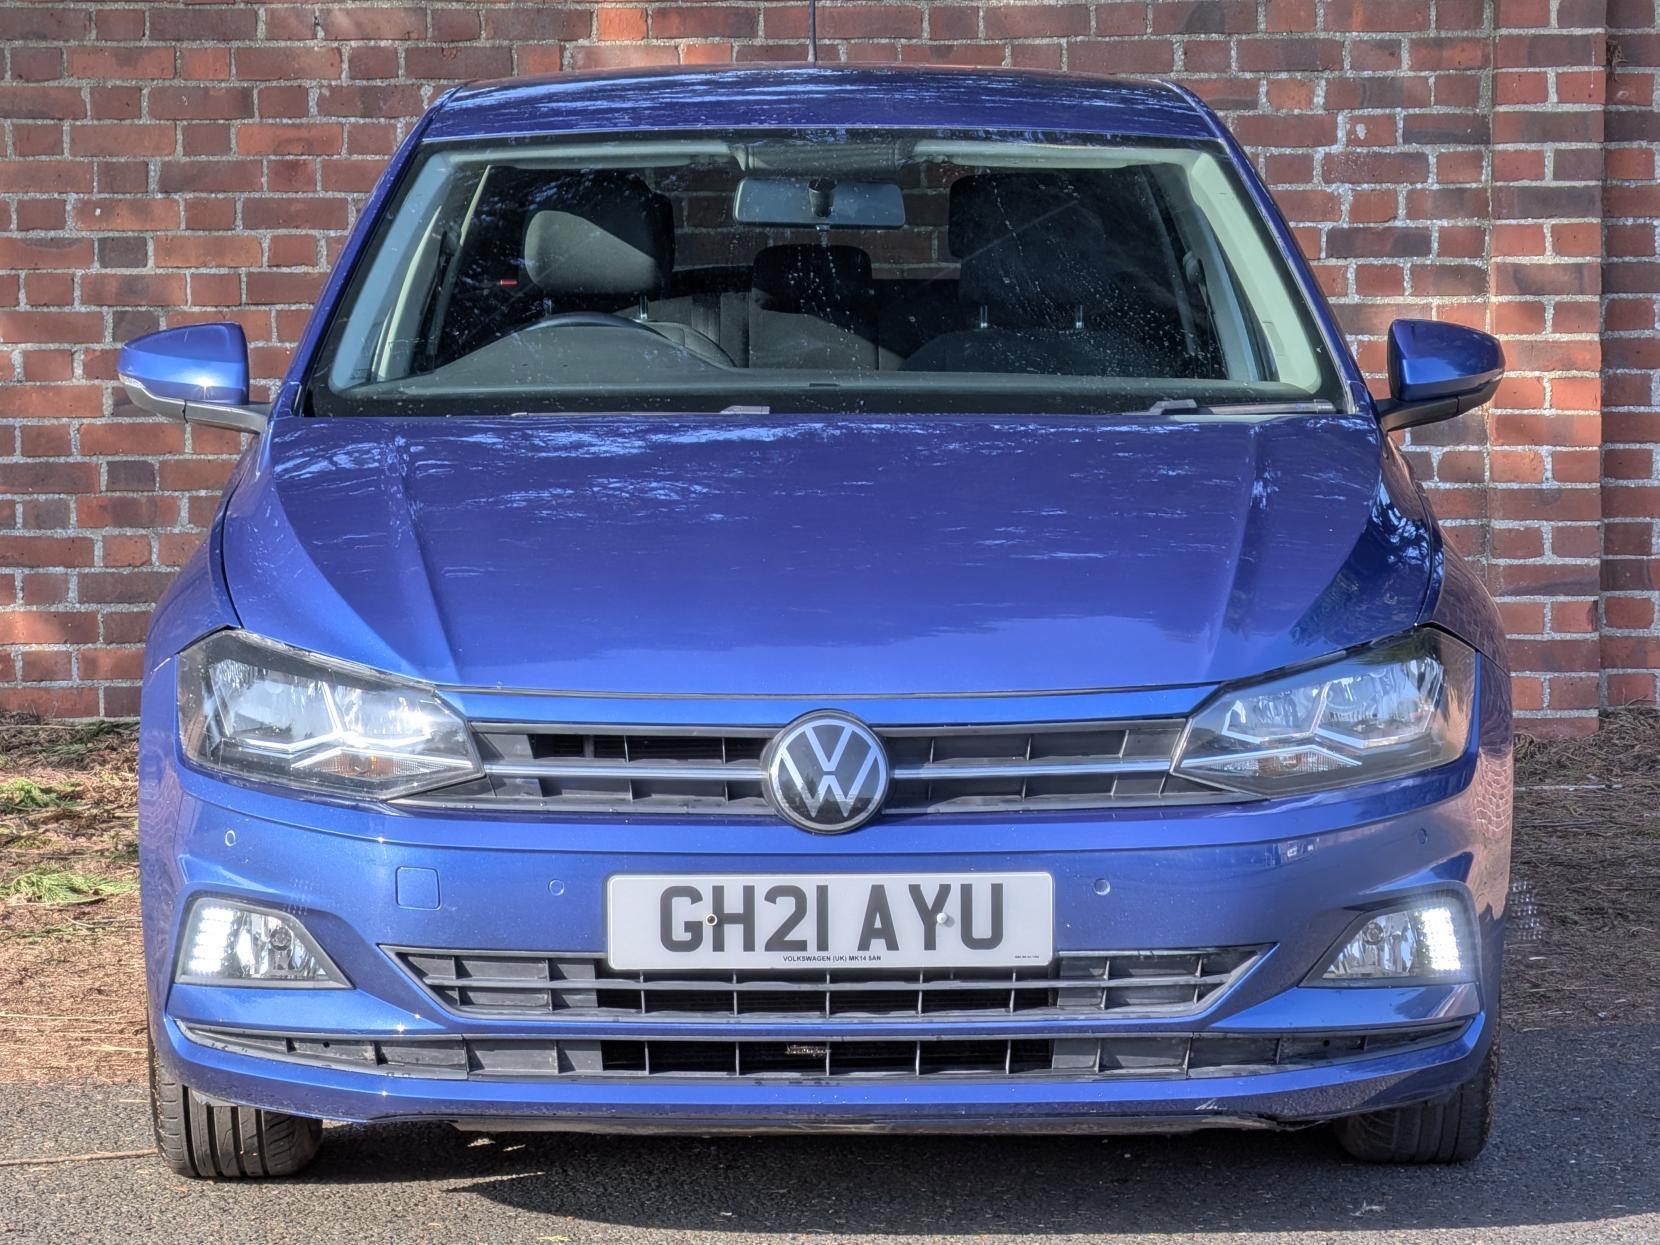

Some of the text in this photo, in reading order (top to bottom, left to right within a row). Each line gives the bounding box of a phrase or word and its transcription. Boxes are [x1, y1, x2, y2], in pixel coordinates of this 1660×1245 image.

[779, 723, 879, 819] VW
[659, 883, 1004, 953] GH21 AYU
[832, 955, 848, 963] (UK)
